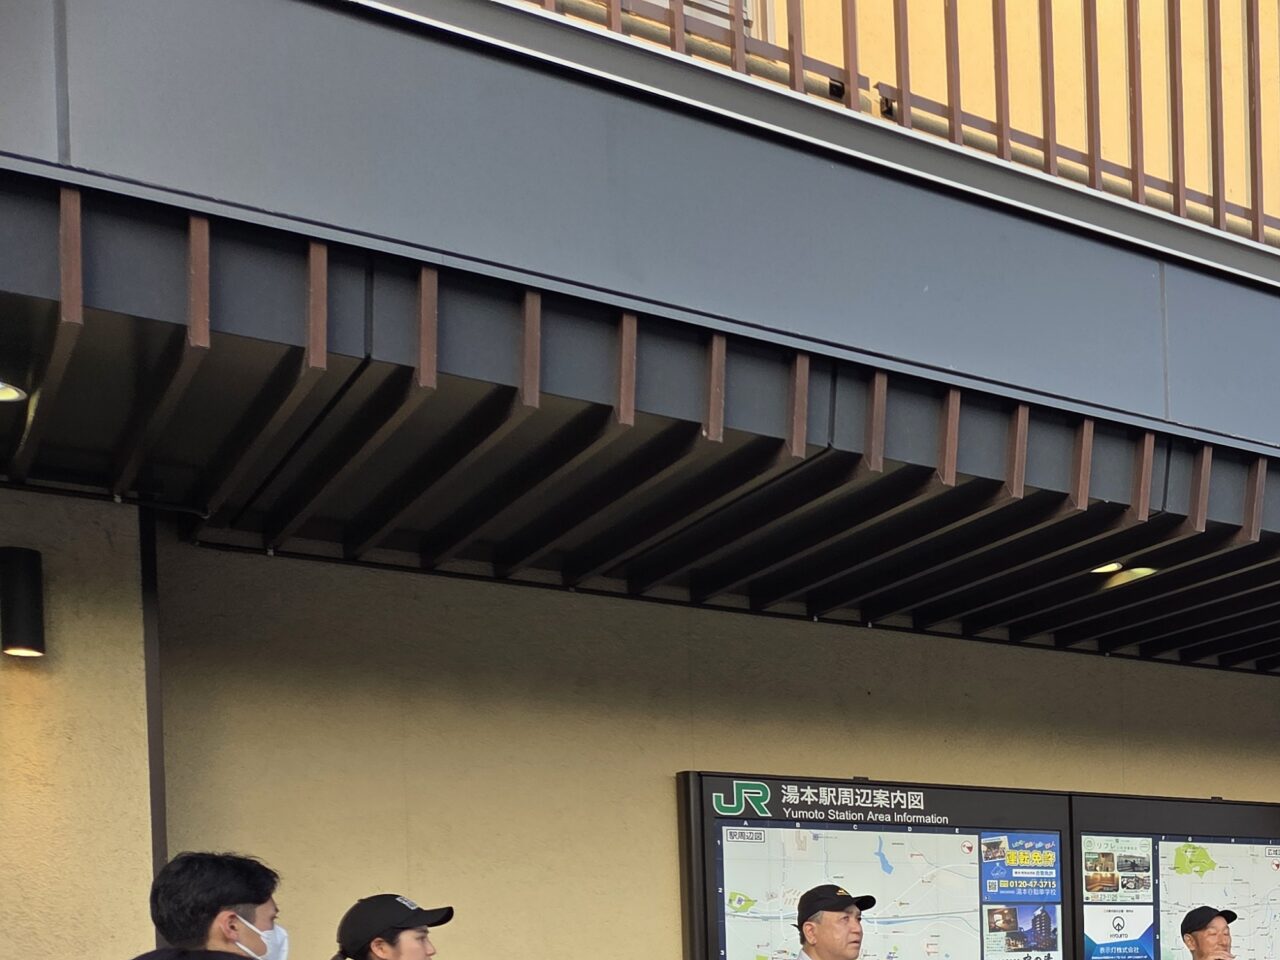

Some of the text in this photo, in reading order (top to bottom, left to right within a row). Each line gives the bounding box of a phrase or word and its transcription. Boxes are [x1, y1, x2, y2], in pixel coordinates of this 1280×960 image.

[713, 780, 924, 817] JR 湯本駅周辺案内図
[783, 807, 949, 825] Yumoto Station Area Information
